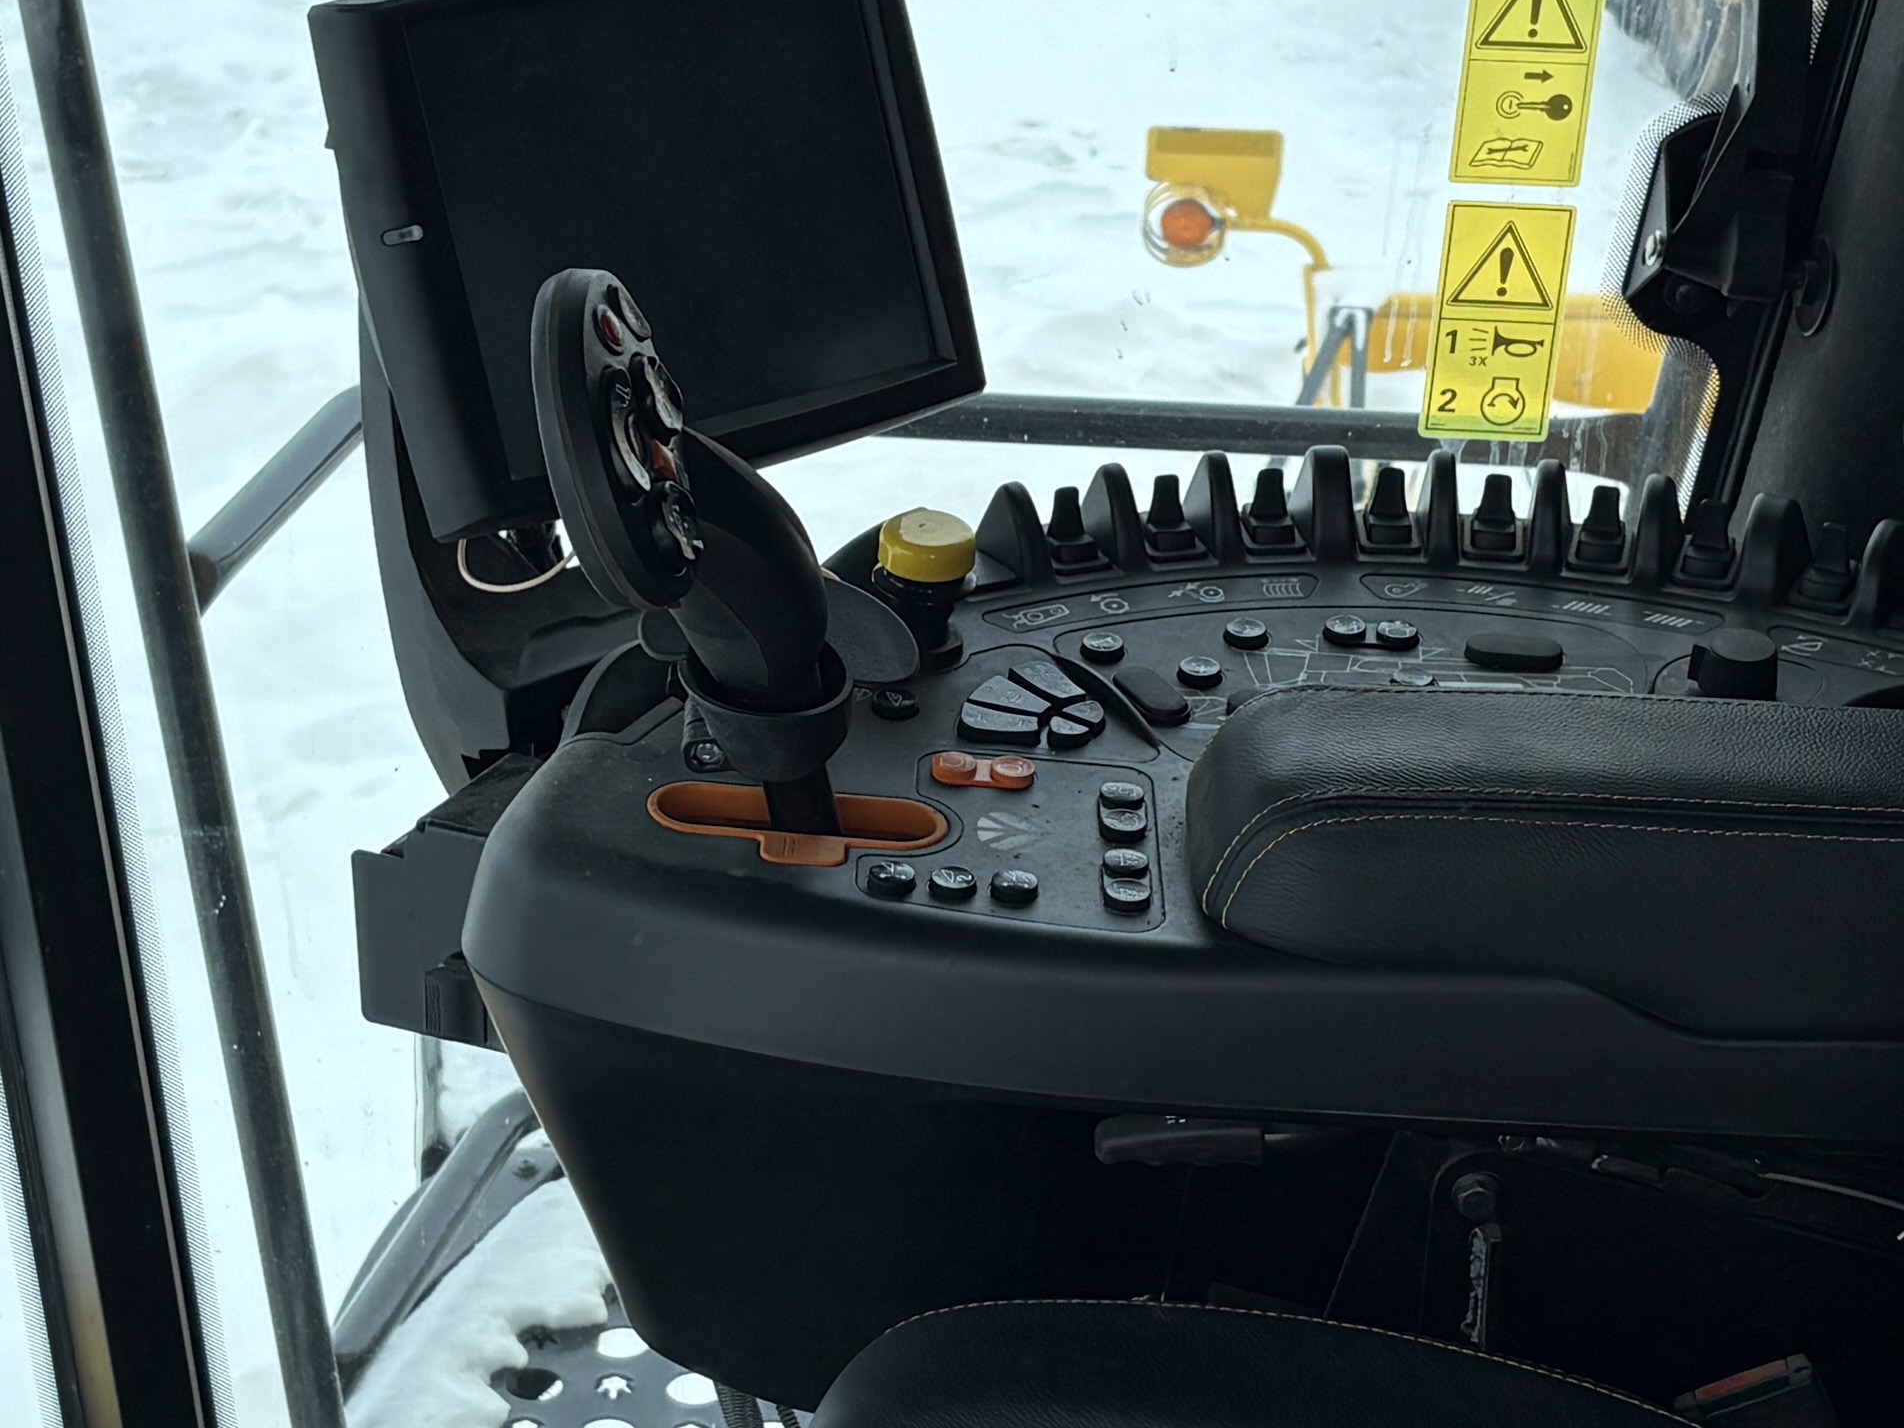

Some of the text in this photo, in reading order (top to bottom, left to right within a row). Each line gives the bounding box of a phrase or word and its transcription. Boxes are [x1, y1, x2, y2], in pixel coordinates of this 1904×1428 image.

[1445, 329, 1459, 354] 1
[1468, 356, 1487, 367] 3X
[1437, 388, 1457, 413] 2
